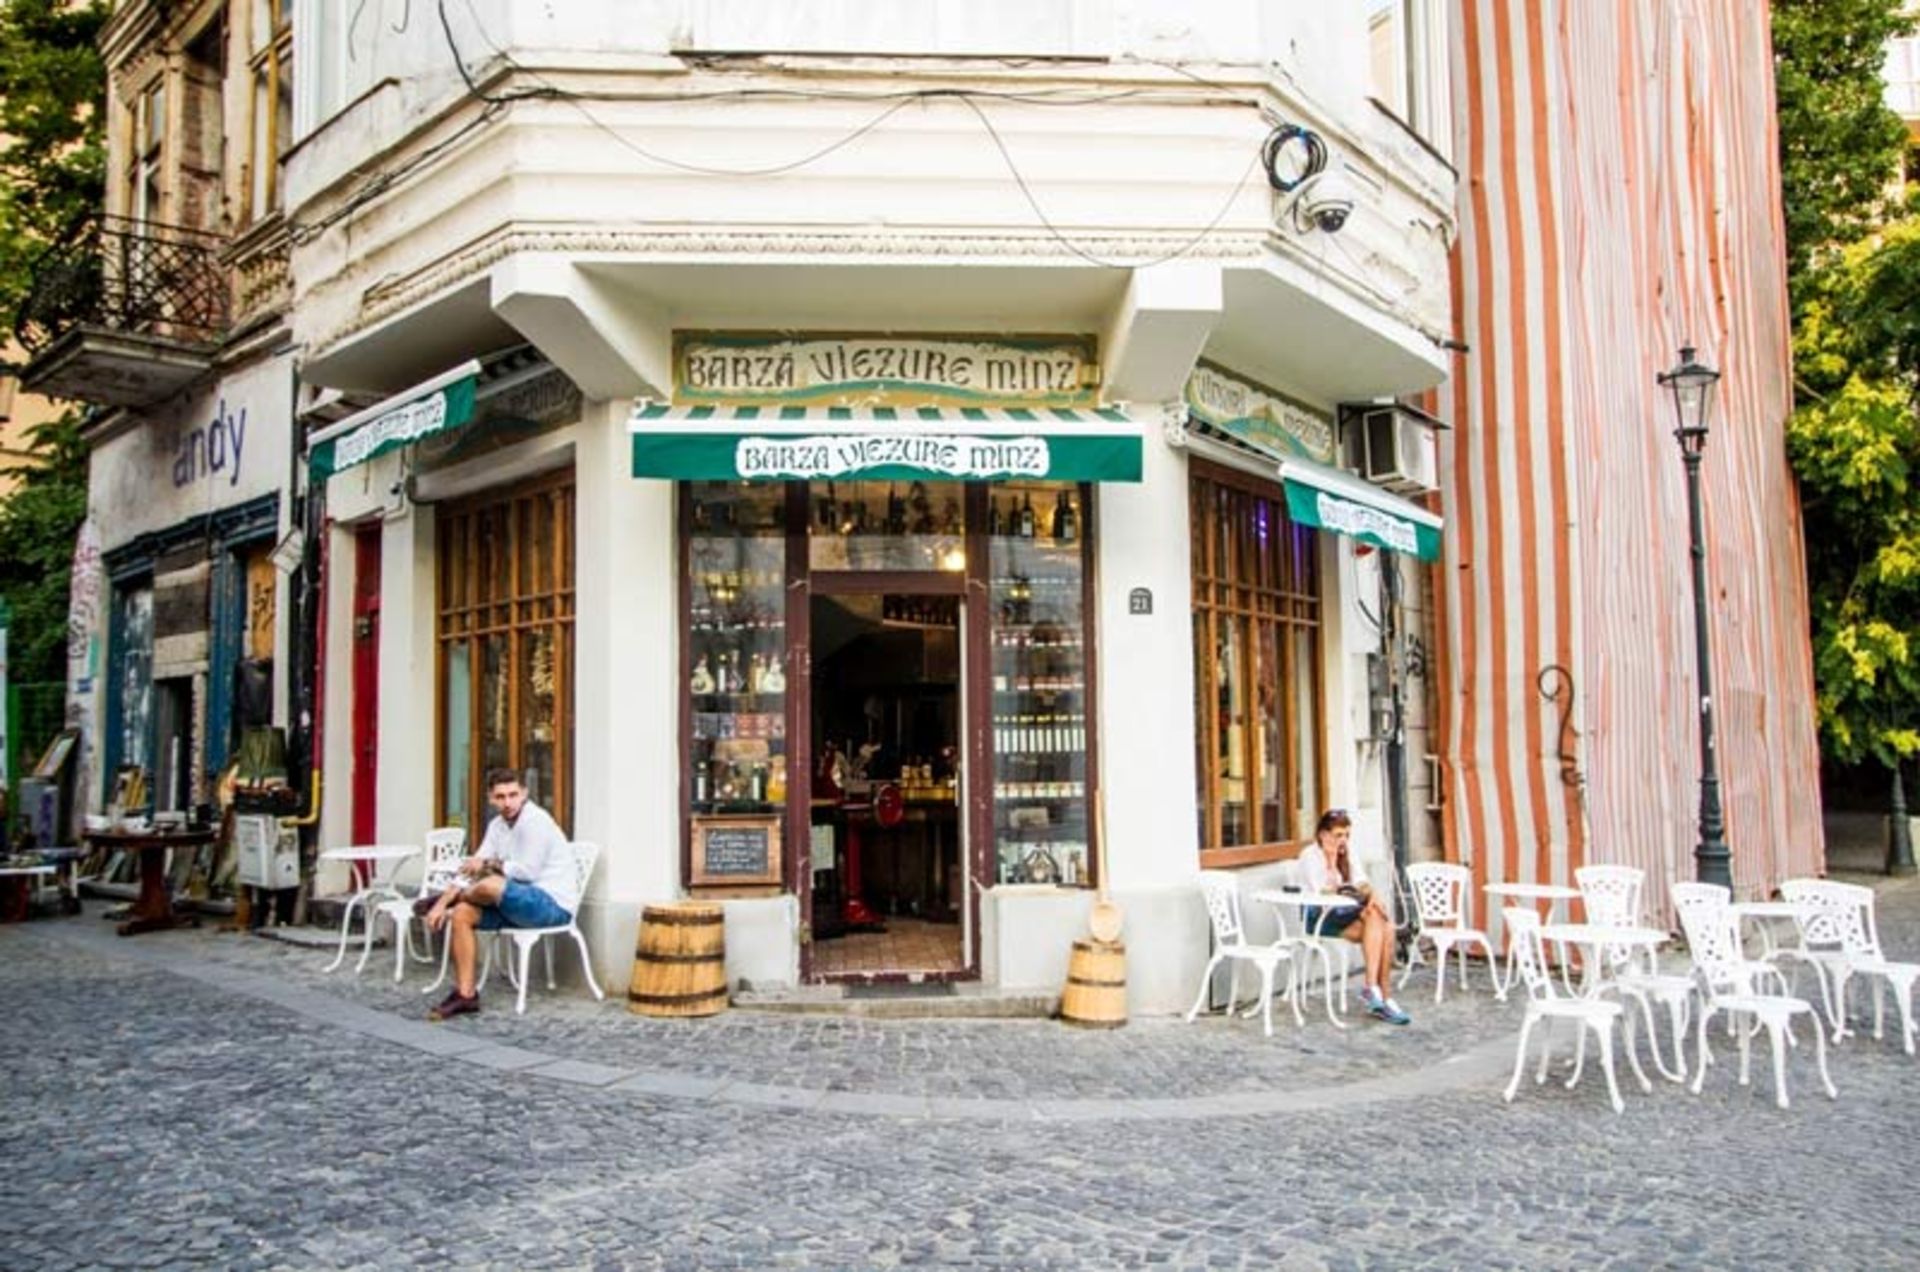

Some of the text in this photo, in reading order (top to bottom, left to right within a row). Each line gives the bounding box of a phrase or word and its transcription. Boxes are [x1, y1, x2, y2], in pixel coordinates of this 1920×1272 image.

[810, 345, 973, 386] VIEZURE
[173, 398, 246, 487] andy
[838, 437, 958, 468] VIEZURE
[1132, 597, 1148, 610] 21
